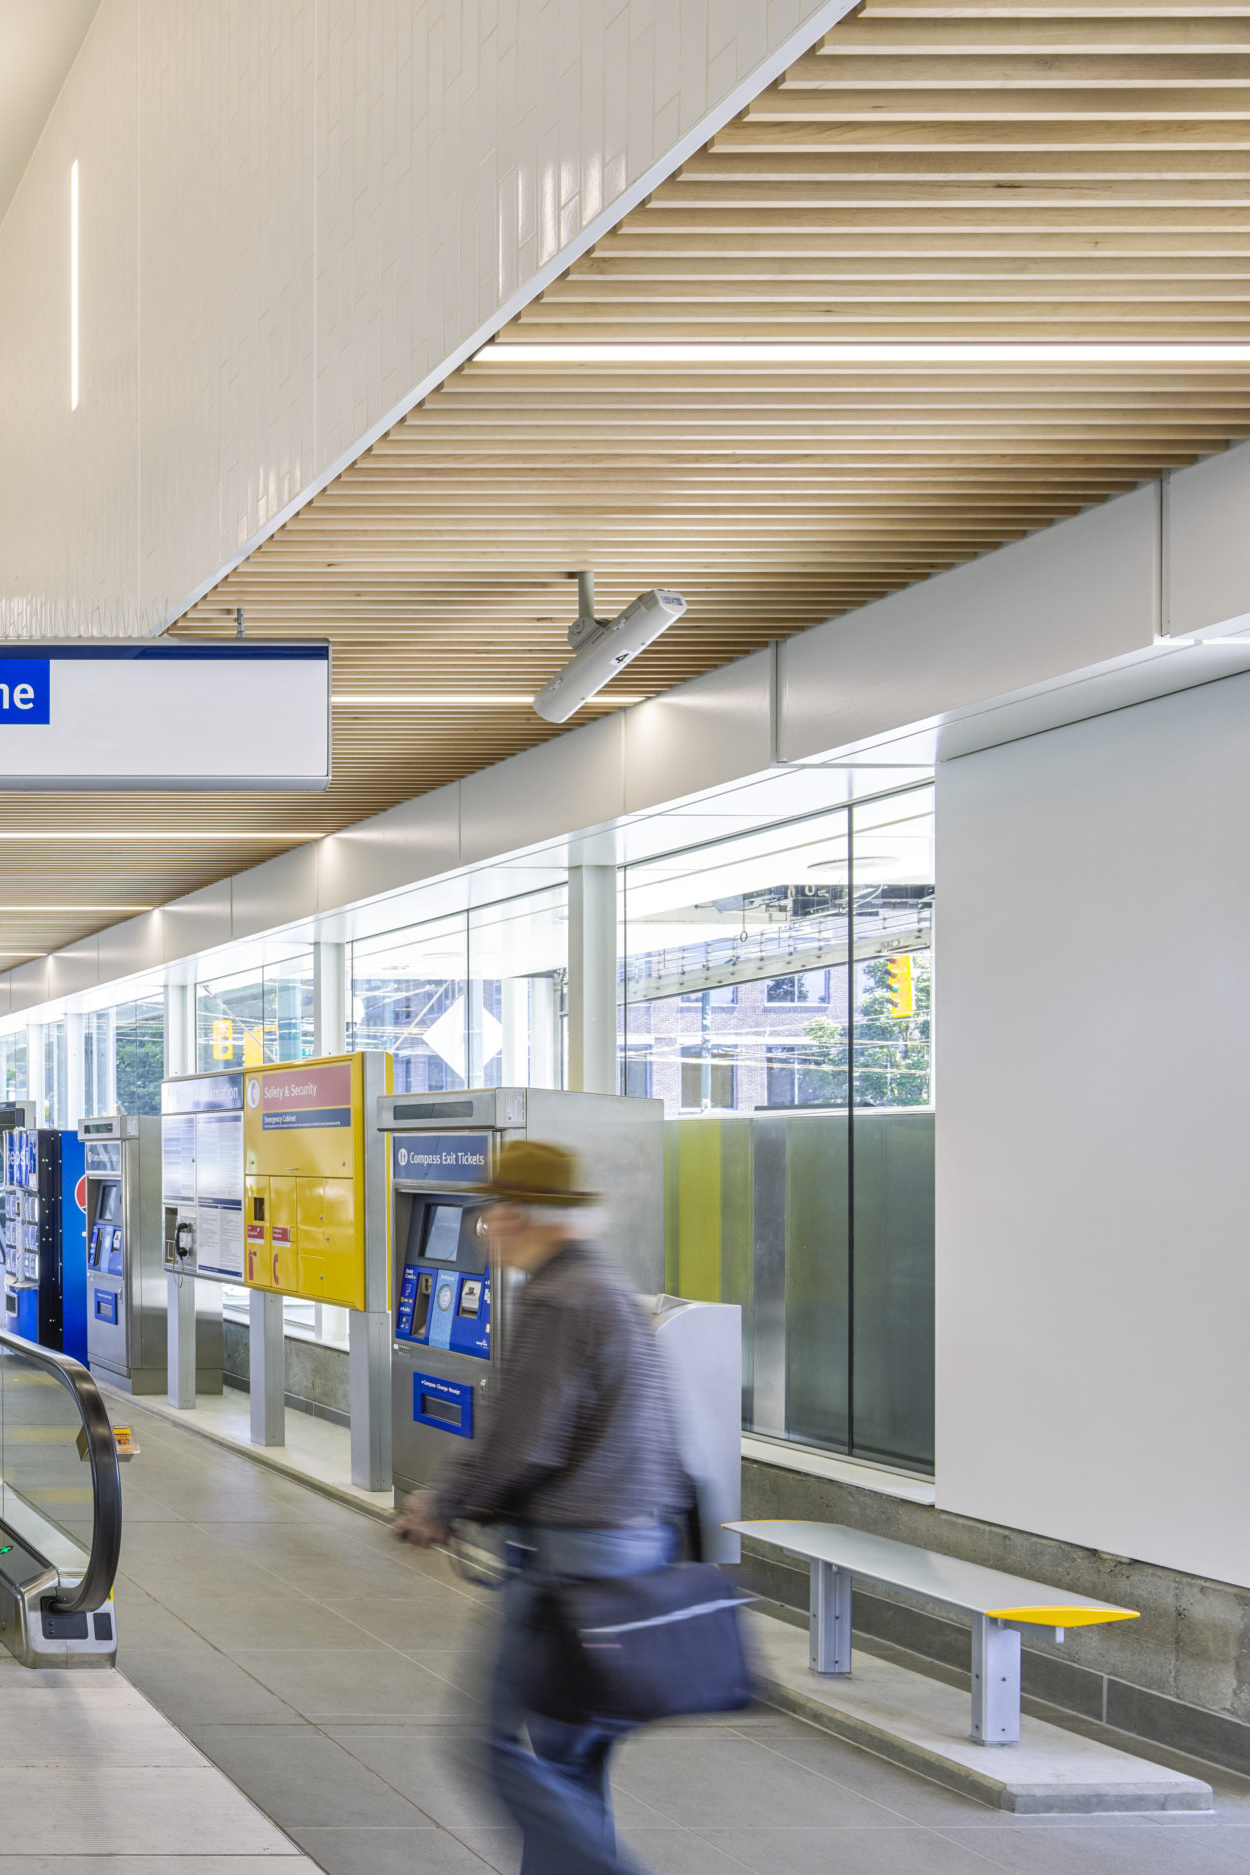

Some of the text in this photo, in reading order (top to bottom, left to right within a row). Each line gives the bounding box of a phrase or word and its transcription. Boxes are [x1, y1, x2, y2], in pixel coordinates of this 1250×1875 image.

[264, 1082, 317, 1100] Safety & Security
[264, 1115, 283, 1124] Emergency
[409, 1151, 485, 1167] Compass Exit Tickets
